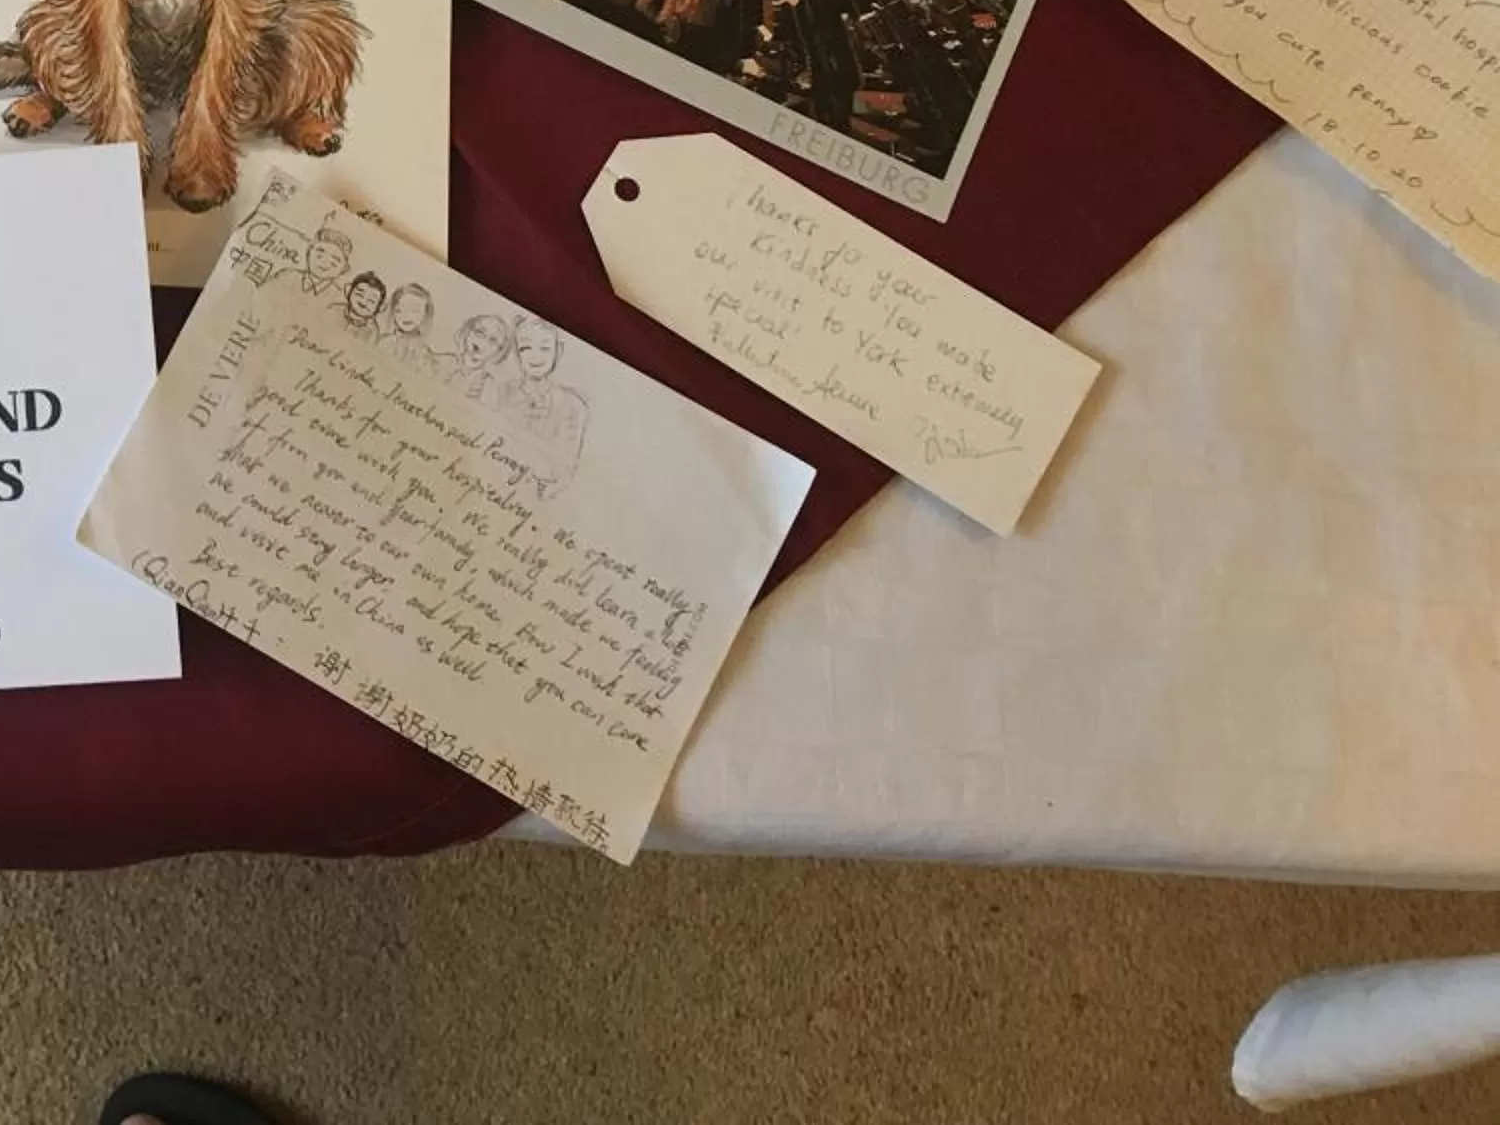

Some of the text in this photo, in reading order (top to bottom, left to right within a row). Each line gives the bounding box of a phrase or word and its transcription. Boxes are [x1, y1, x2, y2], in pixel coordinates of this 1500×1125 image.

[763, 110, 930, 204] FREIBURG
[230, 246, 275, 290] 中国
[246, 221, 300, 264] China
[293, 367, 357, 422] Thanks
[355, 409, 393, 440] for
[389, 439, 441, 467] your
[244, 383, 306, 435] good
[594, 583, 640, 631] learn
